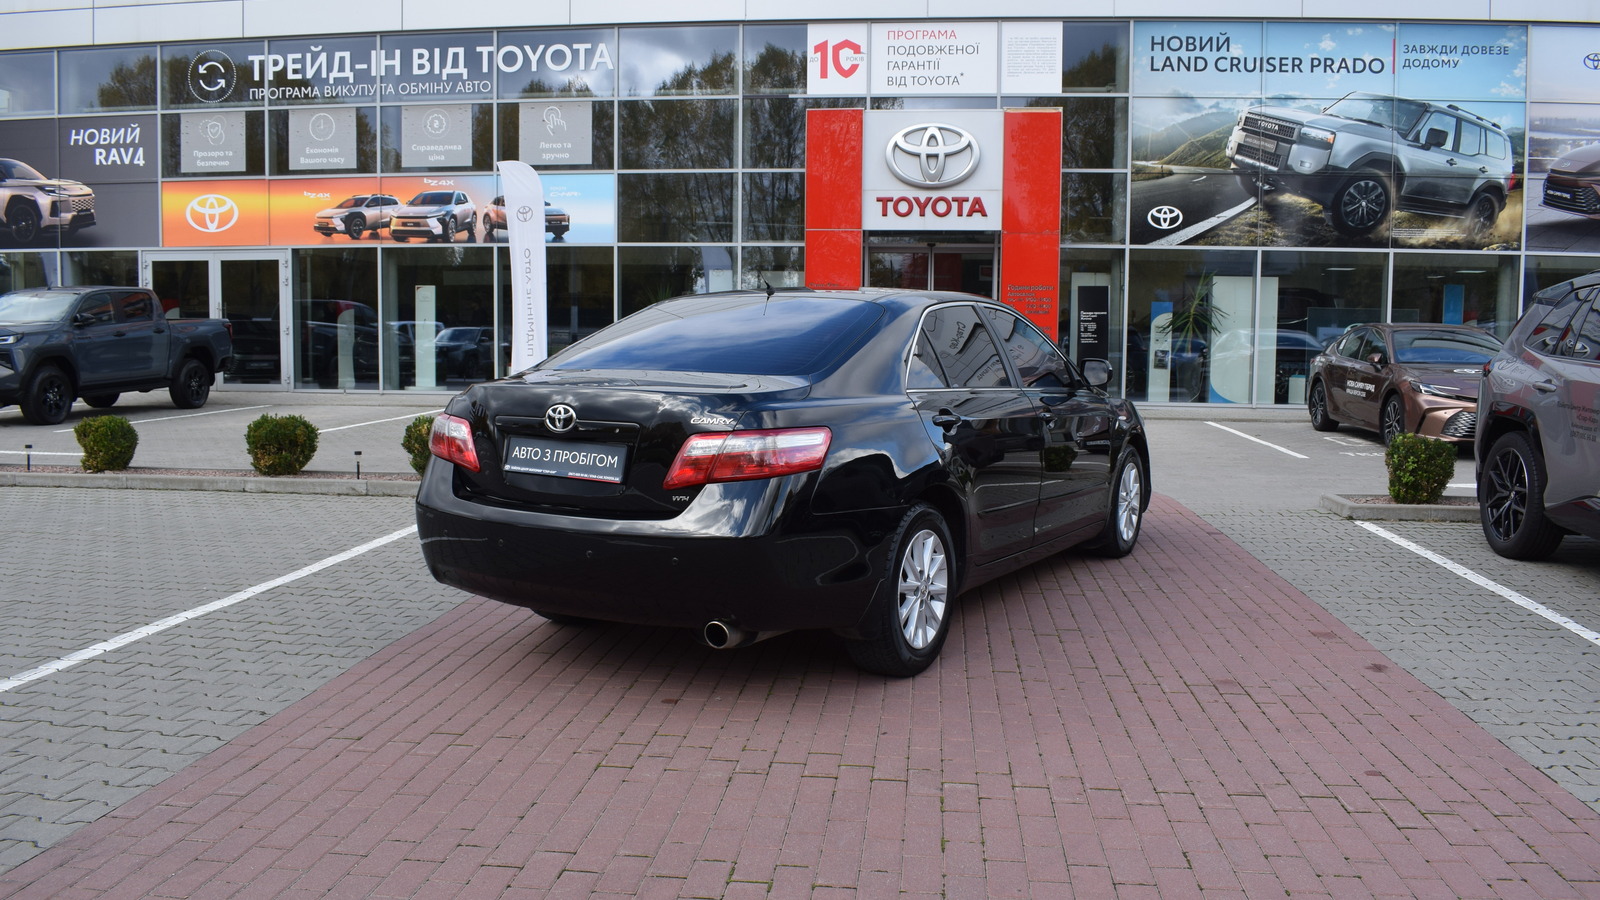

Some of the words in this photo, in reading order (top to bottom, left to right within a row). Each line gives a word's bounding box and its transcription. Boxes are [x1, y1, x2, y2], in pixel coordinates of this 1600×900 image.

[887, 30, 957, 40] ПРОГРАМА
[1150, 32, 1230, 52] НОВИЙ
[887, 42, 980, 57] ПОДОВЖЕНОЇ
[1402, 44, 1457, 56] ЗАВЖДИ
[1461, 45, 1510, 56] ДОВЕЗЕ
[248, 45, 400, 84] ТРЕЙД-ІН
[412, 47, 468, 80] ВІД
[476, 43, 614, 73] TOYOTA
[887, 58, 940, 70] ГАРАНТІЇ
[1150, 56, 1208, 72] LAND
[1214, 56, 1304, 73] CRUISER
[1310, 57, 1385, 74] PRADO
[1402, 58, 1460, 70] ДОДОМУ
[887, 76, 907, 87] ВІД
[249, 86, 321, 100] ПРОГРАМА
[324, 84, 376, 98] ВИКУПУ
[380, 84, 395, 95] ТА
[398, 82, 453, 94] ОБМІНУ
[456, 80, 492, 94] АВТО
[1258, 120, 1279, 130] TOYOTA
[70, 124, 141, 146] НОВИЙ
[412, 144, 462, 152] Справедлива
[95, 147, 146, 166] RAV4
[428, 154, 445, 162] ціна
[876, 196, 988, 218] TOYOTA
[512, 446, 541, 460] АВТО
[543, 449, 551, 461] З
[554, 450, 619, 469] ПРОБІГОМ
